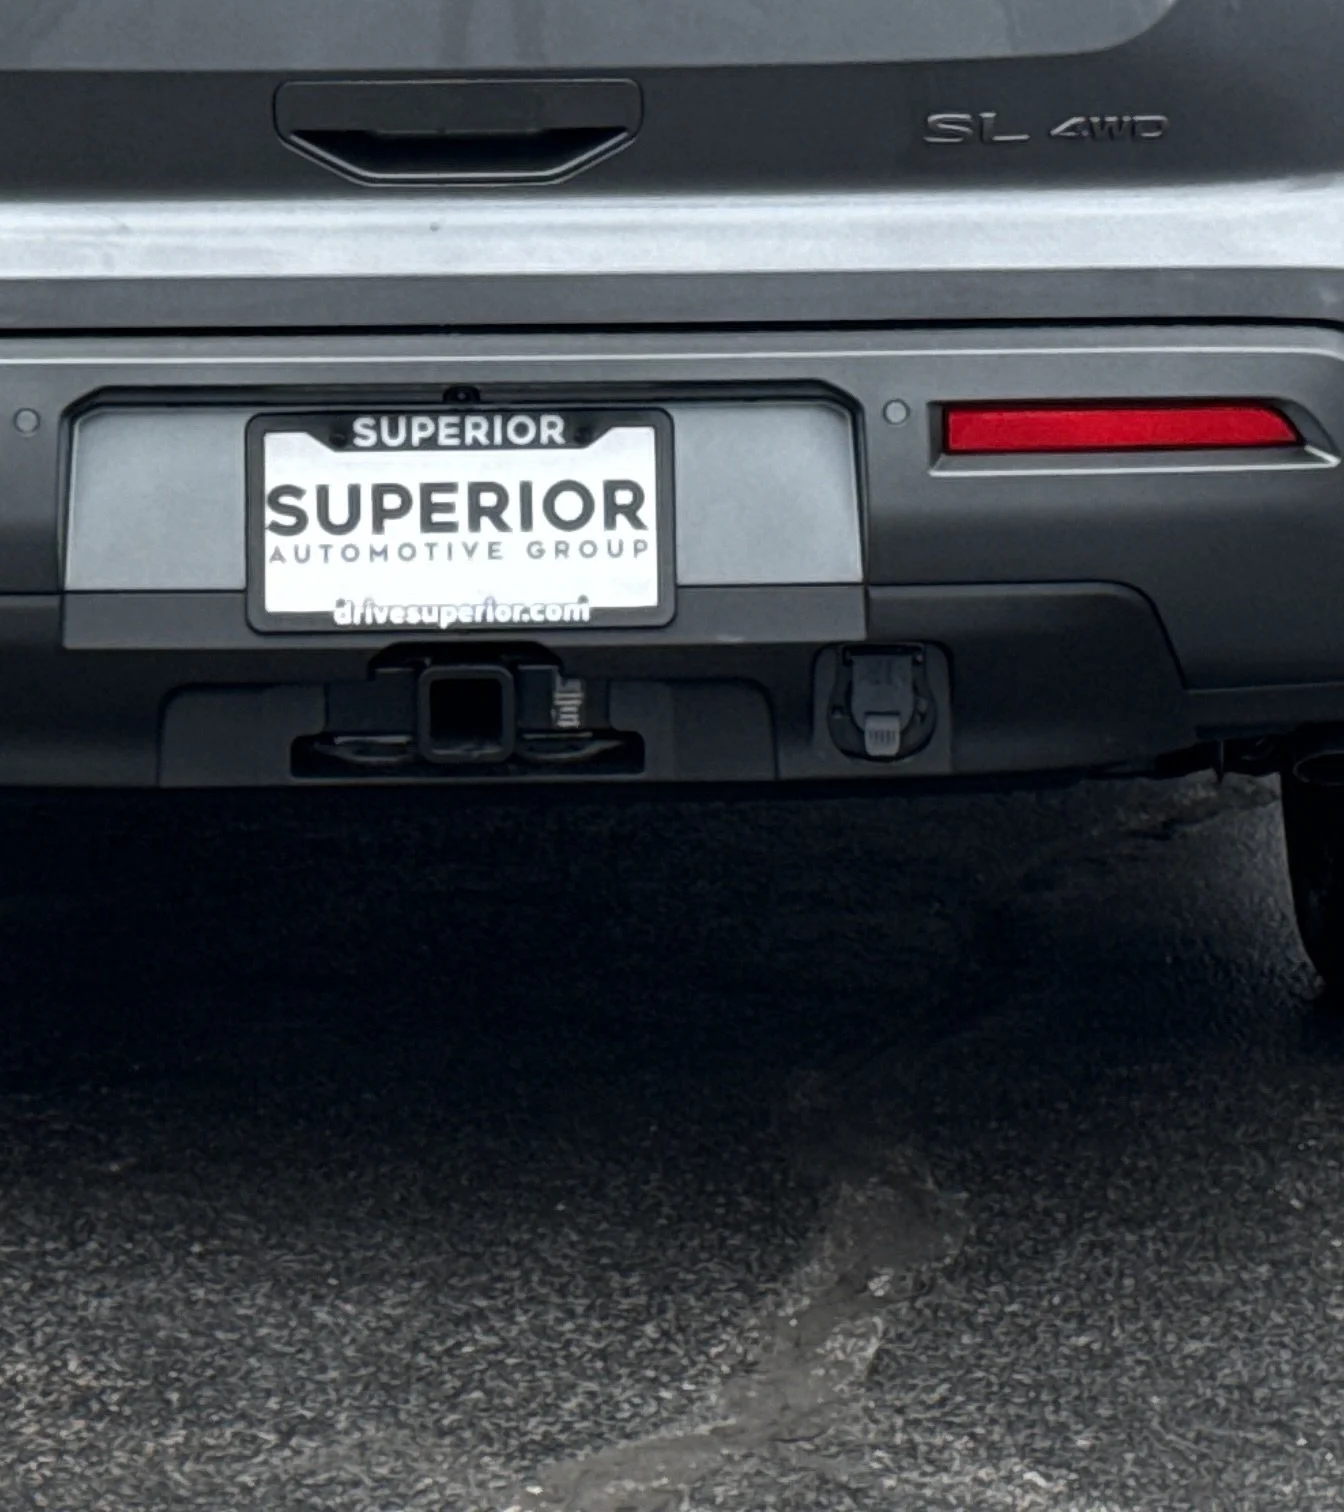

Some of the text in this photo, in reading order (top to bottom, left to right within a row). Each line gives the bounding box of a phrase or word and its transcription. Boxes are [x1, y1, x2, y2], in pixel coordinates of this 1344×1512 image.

[922, 111, 1171, 144] SL 4WD
[352, 413, 567, 449] SUPERIOR
[265, 478, 649, 537] SUPERIOR
[269, 538, 650, 565] AUTOMOTIVE GROUP
